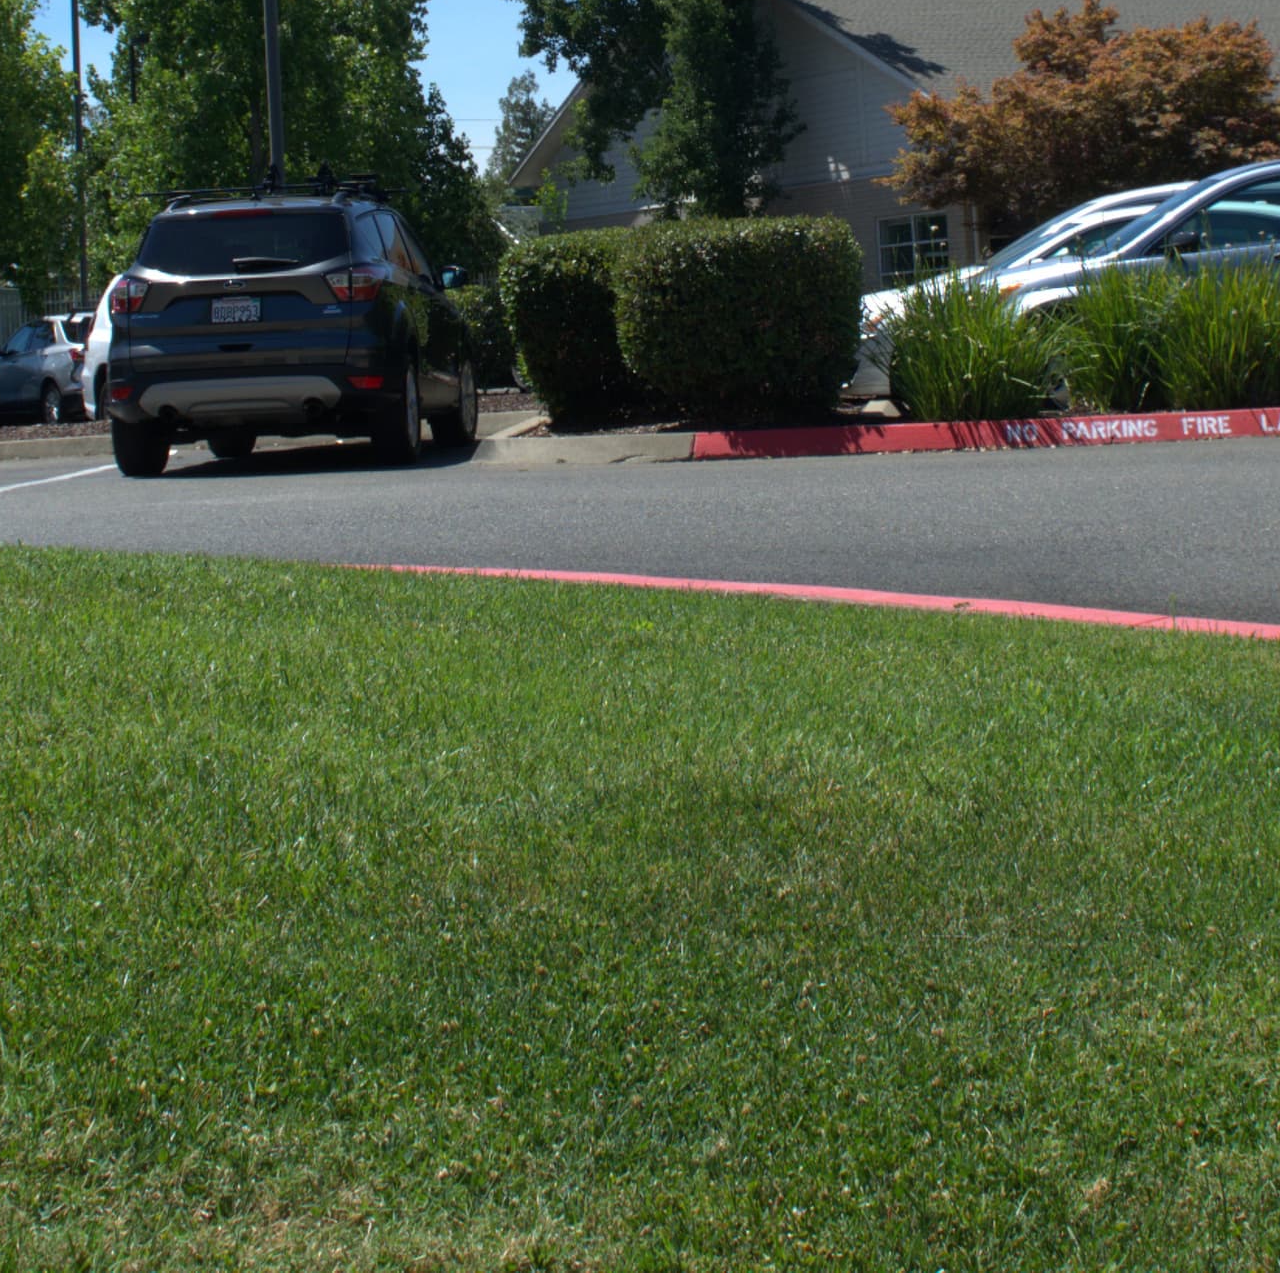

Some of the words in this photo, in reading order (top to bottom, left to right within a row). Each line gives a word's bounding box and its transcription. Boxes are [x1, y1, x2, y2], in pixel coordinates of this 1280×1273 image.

[1005, 422, 1039, 443] NO
[1061, 418, 1159, 441] PARKING
[1181, 414, 1233, 436] FIRE
